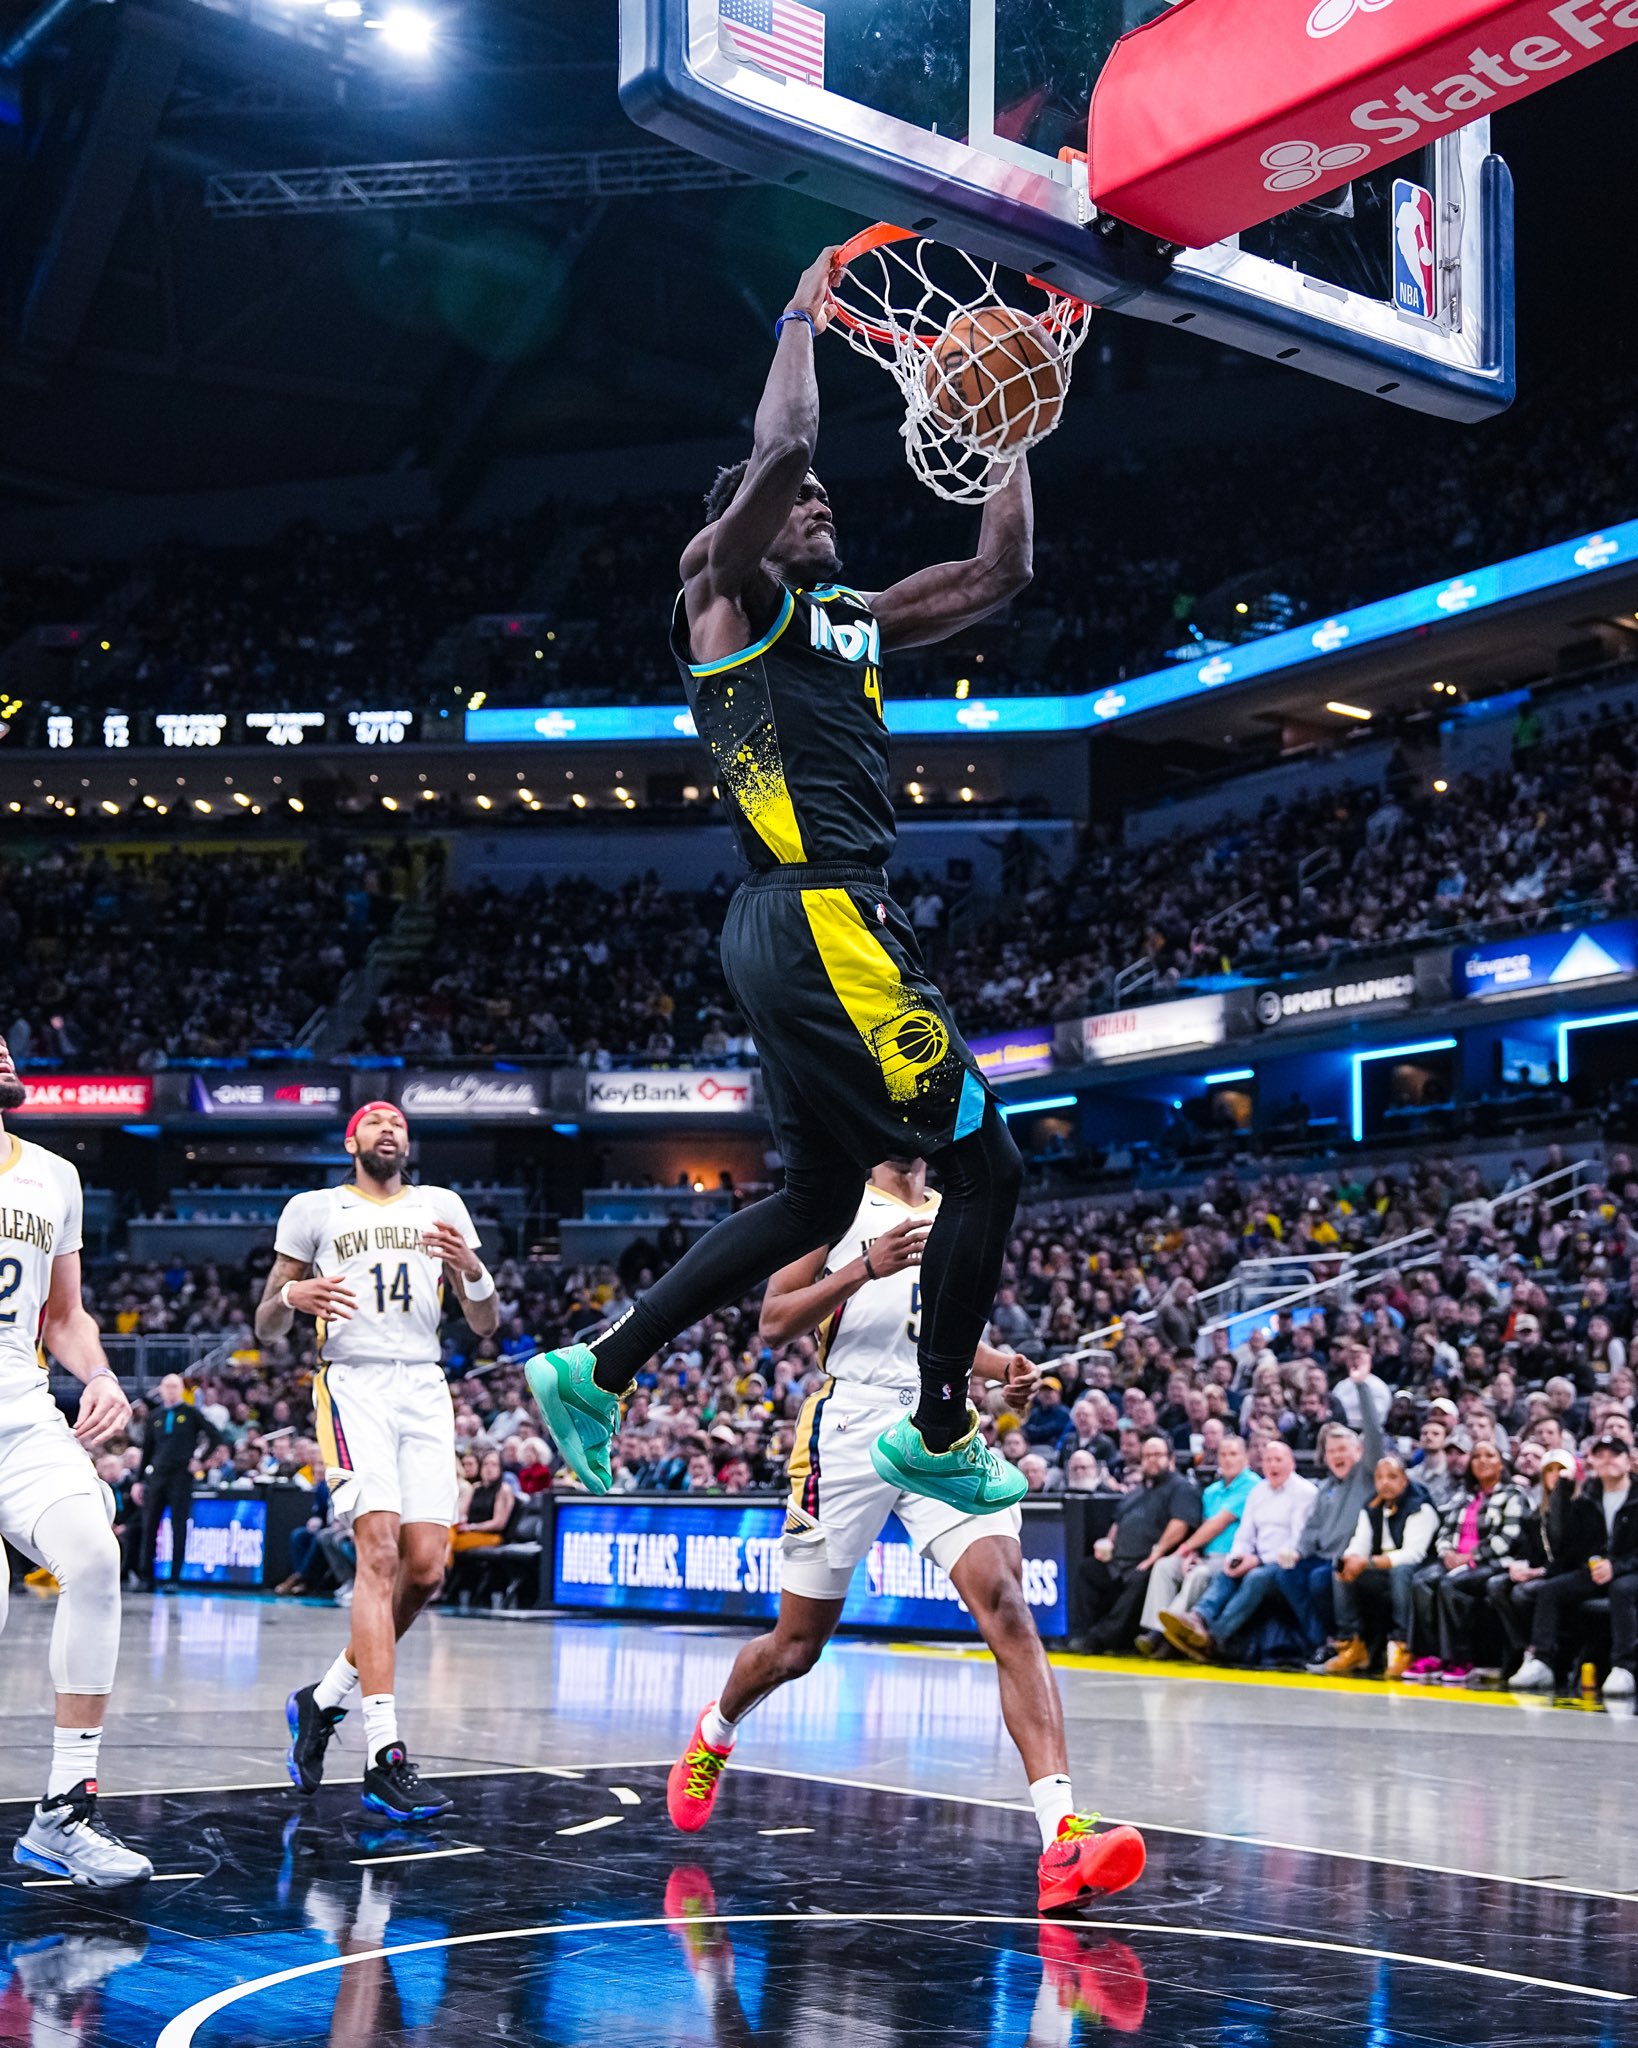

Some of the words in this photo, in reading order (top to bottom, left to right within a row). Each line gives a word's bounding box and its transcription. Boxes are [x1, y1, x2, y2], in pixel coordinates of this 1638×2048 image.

[1350, 36, 1573, 145] State
[1399, 281, 1420, 309] NBA
[810, 604, 880, 666] INDY
[863, 666, 882, 719] 4
[589, 1082, 690, 1105] KeyBank
[0, 1206, 54, 1254] LEANS
[333, 1228, 369, 1264] NEW
[0, 1257, 22, 1324] 2
[369, 1262, 413, 1314] 14
[562, 1531, 615, 1585] MORE
[616, 1532, 683, 1589] TEAMS.
[685, 1534, 743, 1592] MORE
[883, 1542, 923, 1599] NBA
